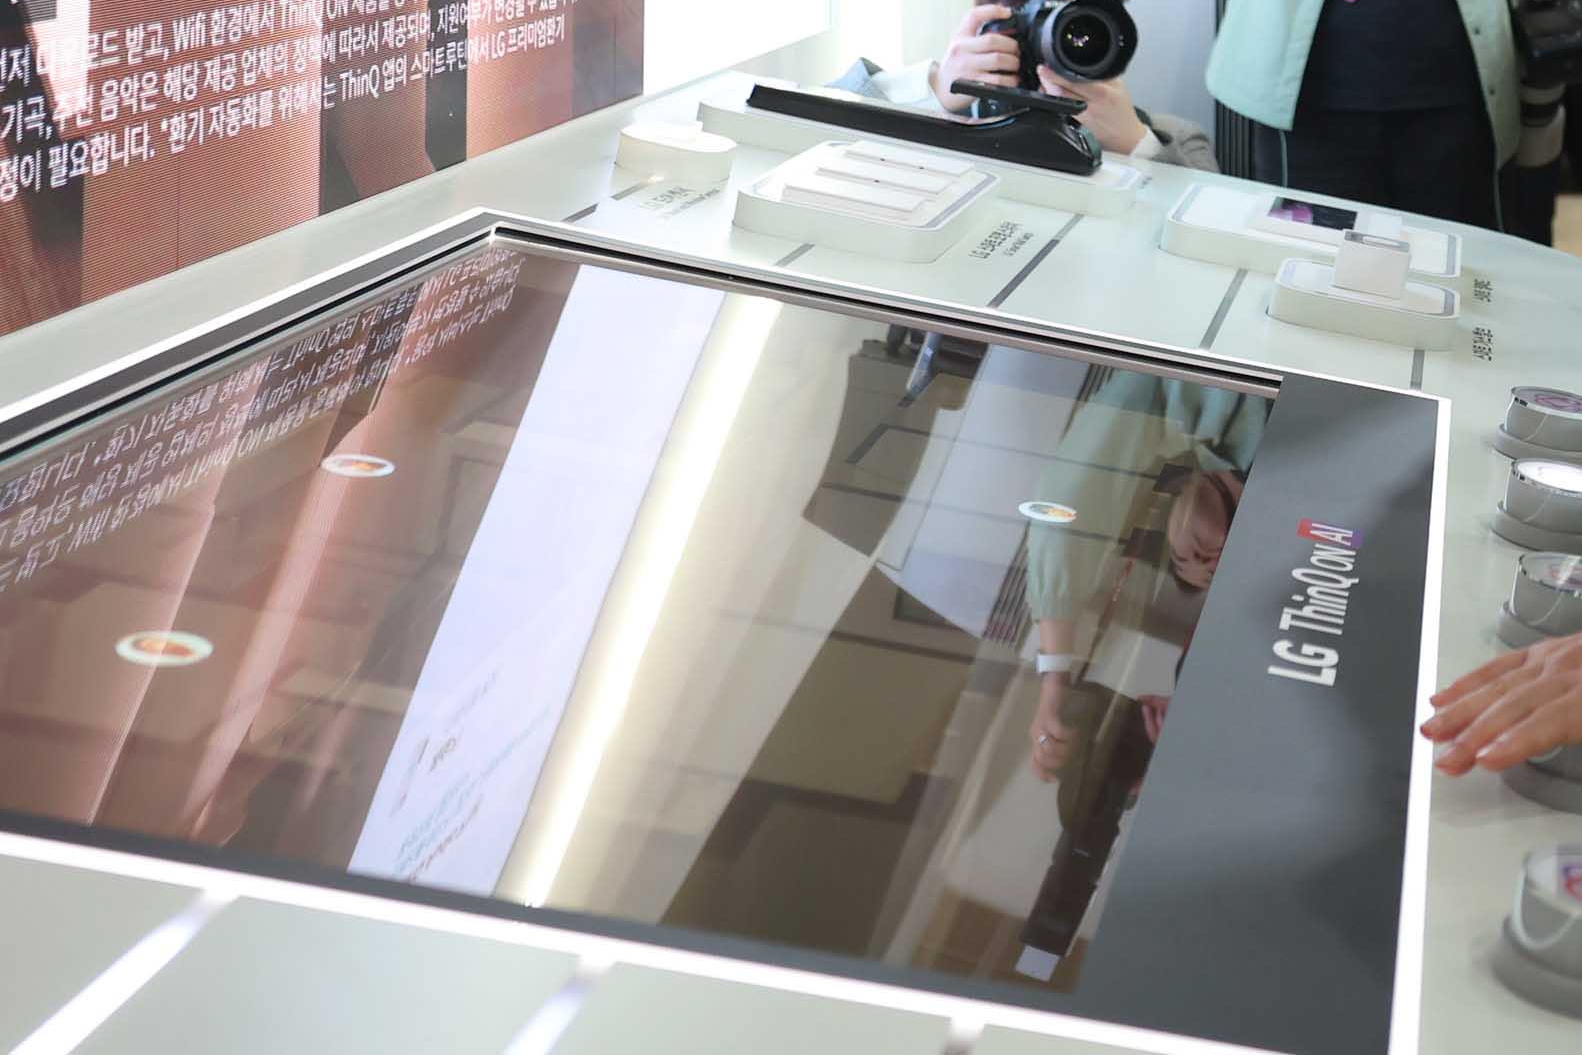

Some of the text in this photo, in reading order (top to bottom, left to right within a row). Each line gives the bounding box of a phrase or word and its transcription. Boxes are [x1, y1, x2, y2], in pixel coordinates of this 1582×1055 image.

[125, 23, 170, 65] 받고,
[210, 0, 275, 45] 환경에서
[100, 71, 160, 123] 음악은
[163, 59, 200, 104] 해당
[203, 52, 238, 94] 제공
[242, 42, 290, 86] 업체의
[339, 20, 380, 60] 따라서
[382, 10, 435, 49] 제공되며,
[48, 122, 156, 190] 필요합니다.
[207, 89, 274, 139] 자동화를
[277, 75, 338, 121] 위해서는
[339, 64, 381, 101] ThinQ
[382, 54, 408, 93] 앱의
[491, 33, 507, 60] LG
[1309, 523, 1353, 546] AI
[1279, 567, 1360, 635] ThinQ
[1268, 639, 1339, 687] LG
